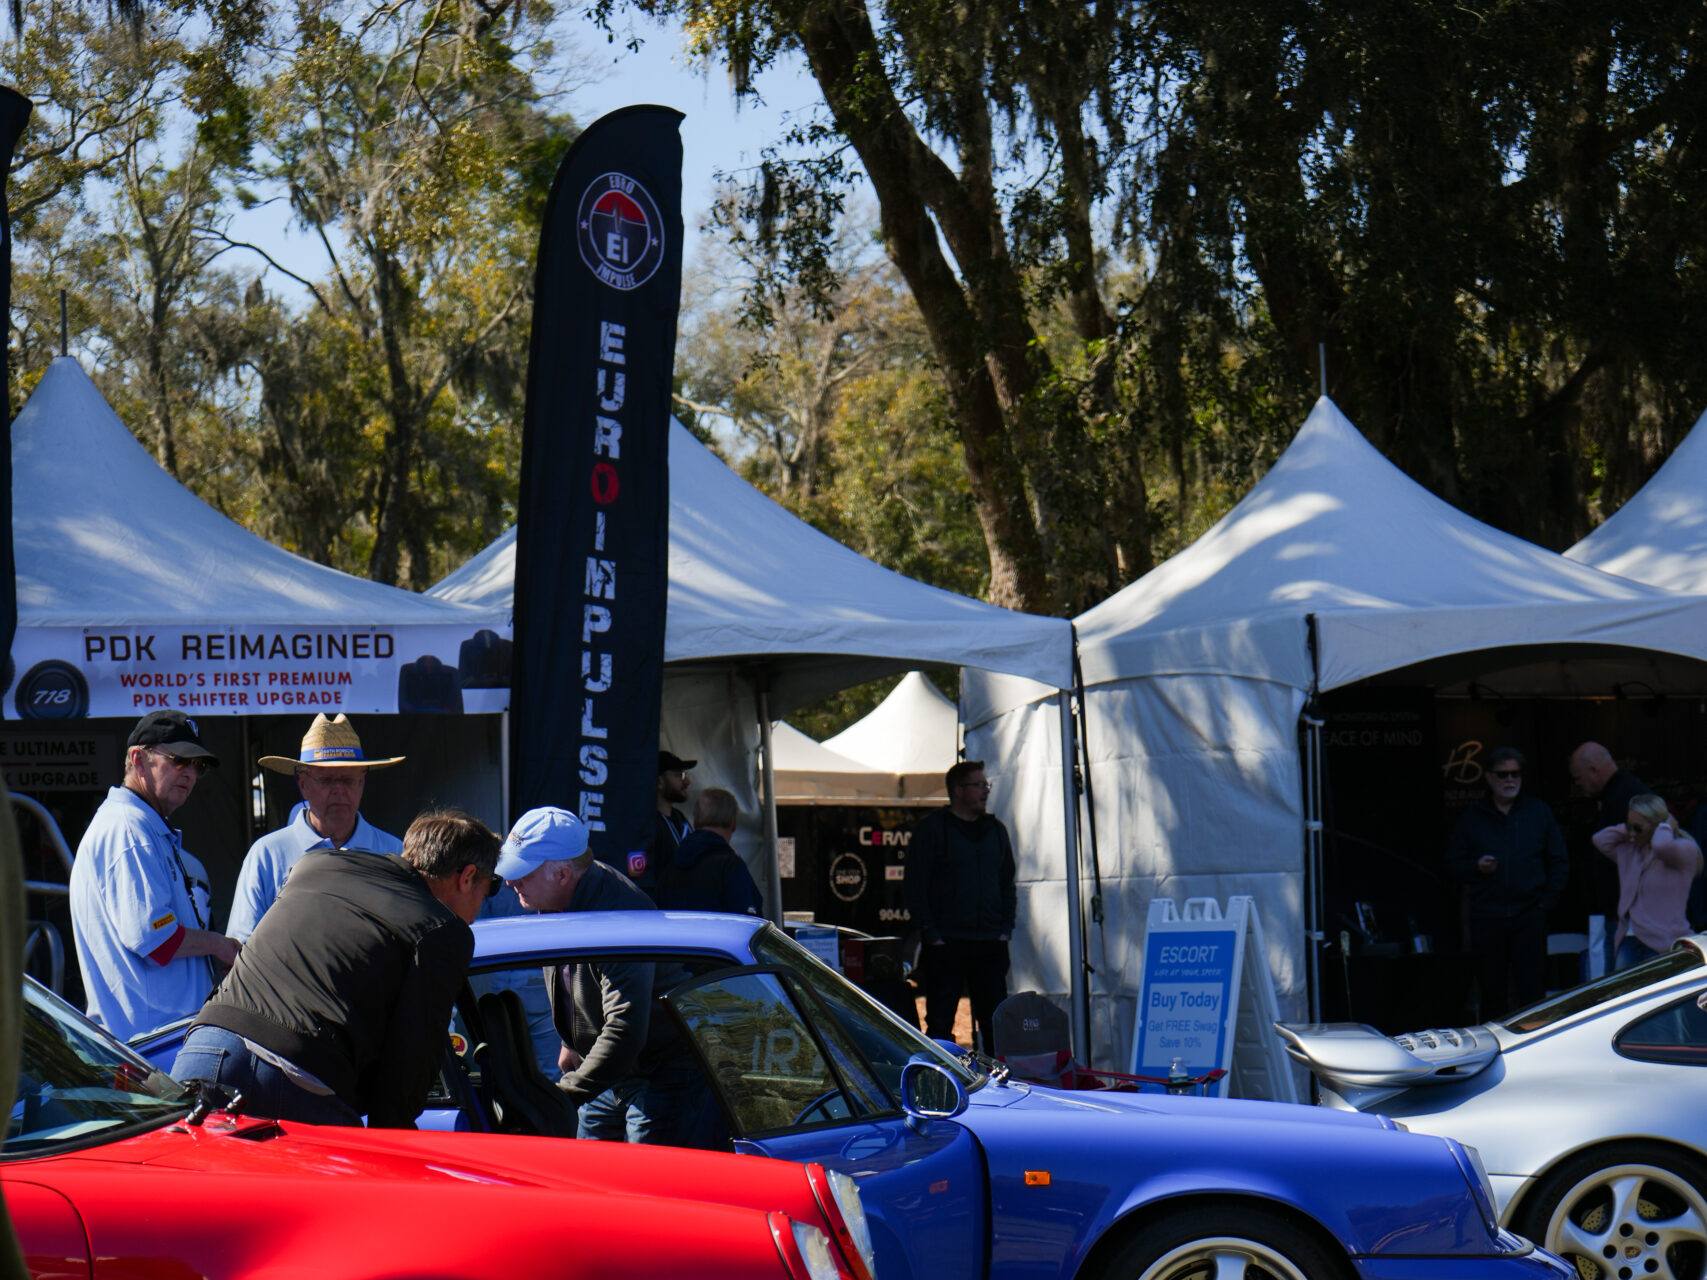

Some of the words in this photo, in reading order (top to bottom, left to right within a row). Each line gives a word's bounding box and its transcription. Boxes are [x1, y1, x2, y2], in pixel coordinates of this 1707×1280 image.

[609, 175, 635, 194] EURO
[606, 231, 629, 264] EI
[597, 263, 637, 288] IMPULSE
[591, 320, 627, 504] EURO
[85, 634, 156, 662] PDK
[181, 633, 395, 660] REIMAGINED
[120, 672, 206, 688] WORLD'S
[214, 672, 260, 687] FIRST
[268, 671, 353, 686] PREMIUM
[578, 511, 617, 833] IMPULSE
[33, 688, 71, 704] 718
[132, 692, 170, 708] PDK
[178, 691, 249, 707] SHIFTER
[256, 690, 342, 706] UPGRADE
[1360, 730, 1380, 747] OF
[1384, 729, 1423, 746] MIND
[14, 741, 96, 756] ULTIMATE
[19, 772, 99, 786] UPGRADE
[1159, 945, 1219, 964] ESCORT
[1151, 992, 1178, 1012] Buy
[1180, 991, 1220, 1011] Today
[1148, 1020, 1165, 1032] Get
[1166, 1020, 1190, 1032] FREE
[1193, 1020, 1217, 1034] Swag
[1159, 1036, 1181, 1048] Save
